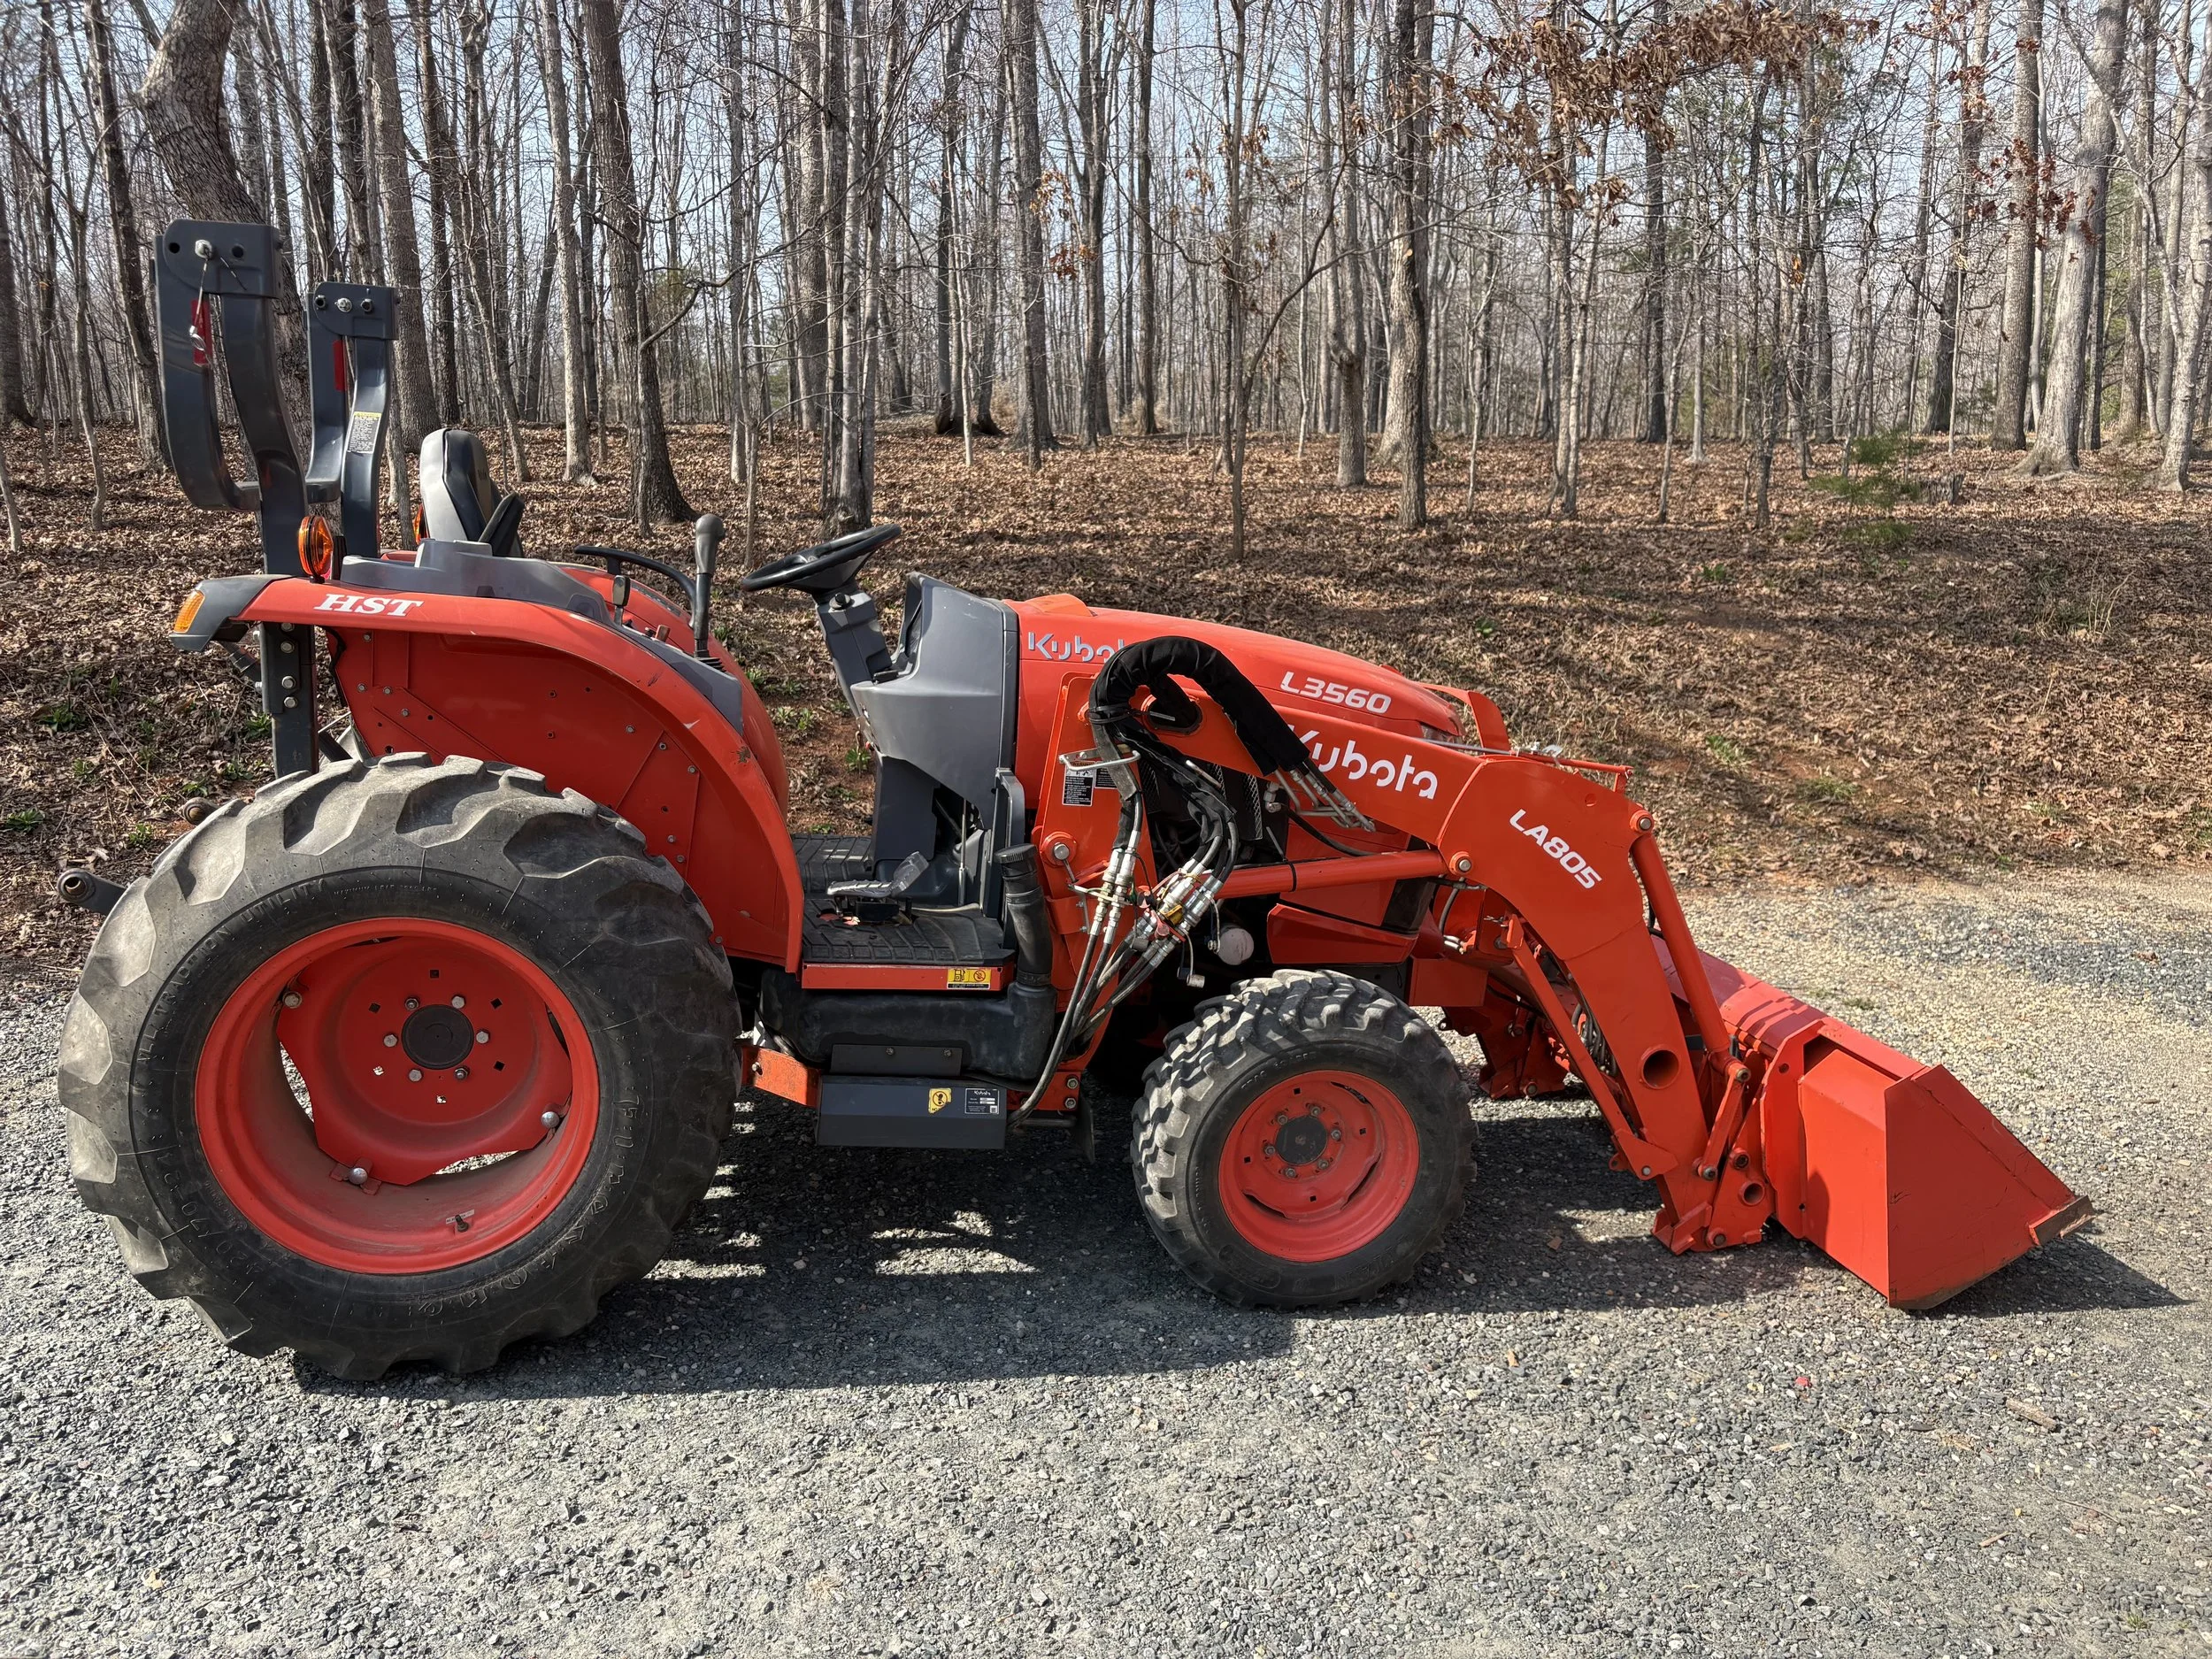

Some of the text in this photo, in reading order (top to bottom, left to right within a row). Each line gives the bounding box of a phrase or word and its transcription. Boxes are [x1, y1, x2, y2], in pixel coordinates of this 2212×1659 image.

[313, 594, 424, 617] HST
[1028, 631, 1126, 663] Kubo
[1280, 671, 1392, 714] L3560
[1509, 808, 1602, 889] LA805
[239, 878, 327, 923] UTILITY
